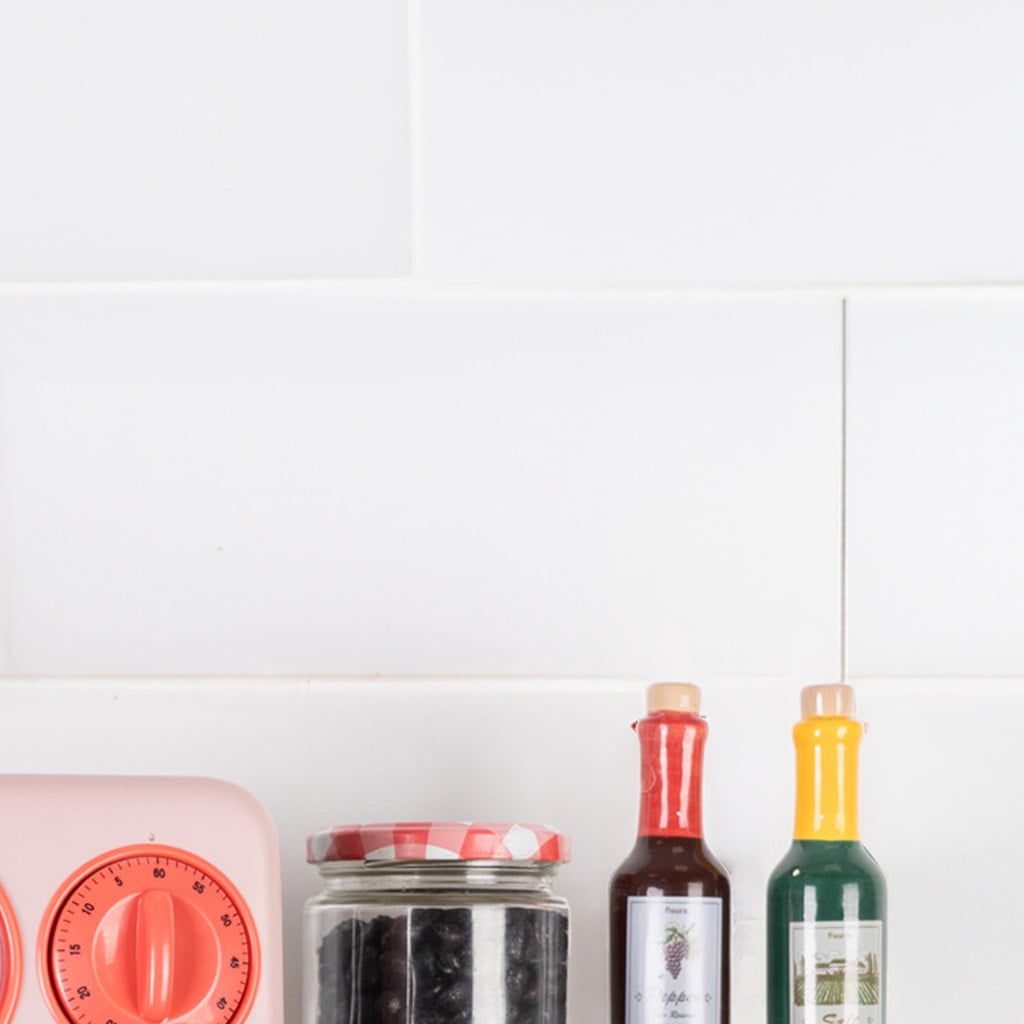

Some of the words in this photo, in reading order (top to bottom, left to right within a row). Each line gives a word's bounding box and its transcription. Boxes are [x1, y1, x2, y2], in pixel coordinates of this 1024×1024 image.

[153, 868, 166, 879] 60
[114, 876, 124, 887] 5
[192, 880, 205, 894] 55
[81, 902, 95, 916] 10
[220, 914, 232, 927] 50
[69, 943, 81, 956] 15
[230, 956, 240, 969] 45
[77, 986, 91, 1000] 20
[216, 997, 228, 1010] 40
